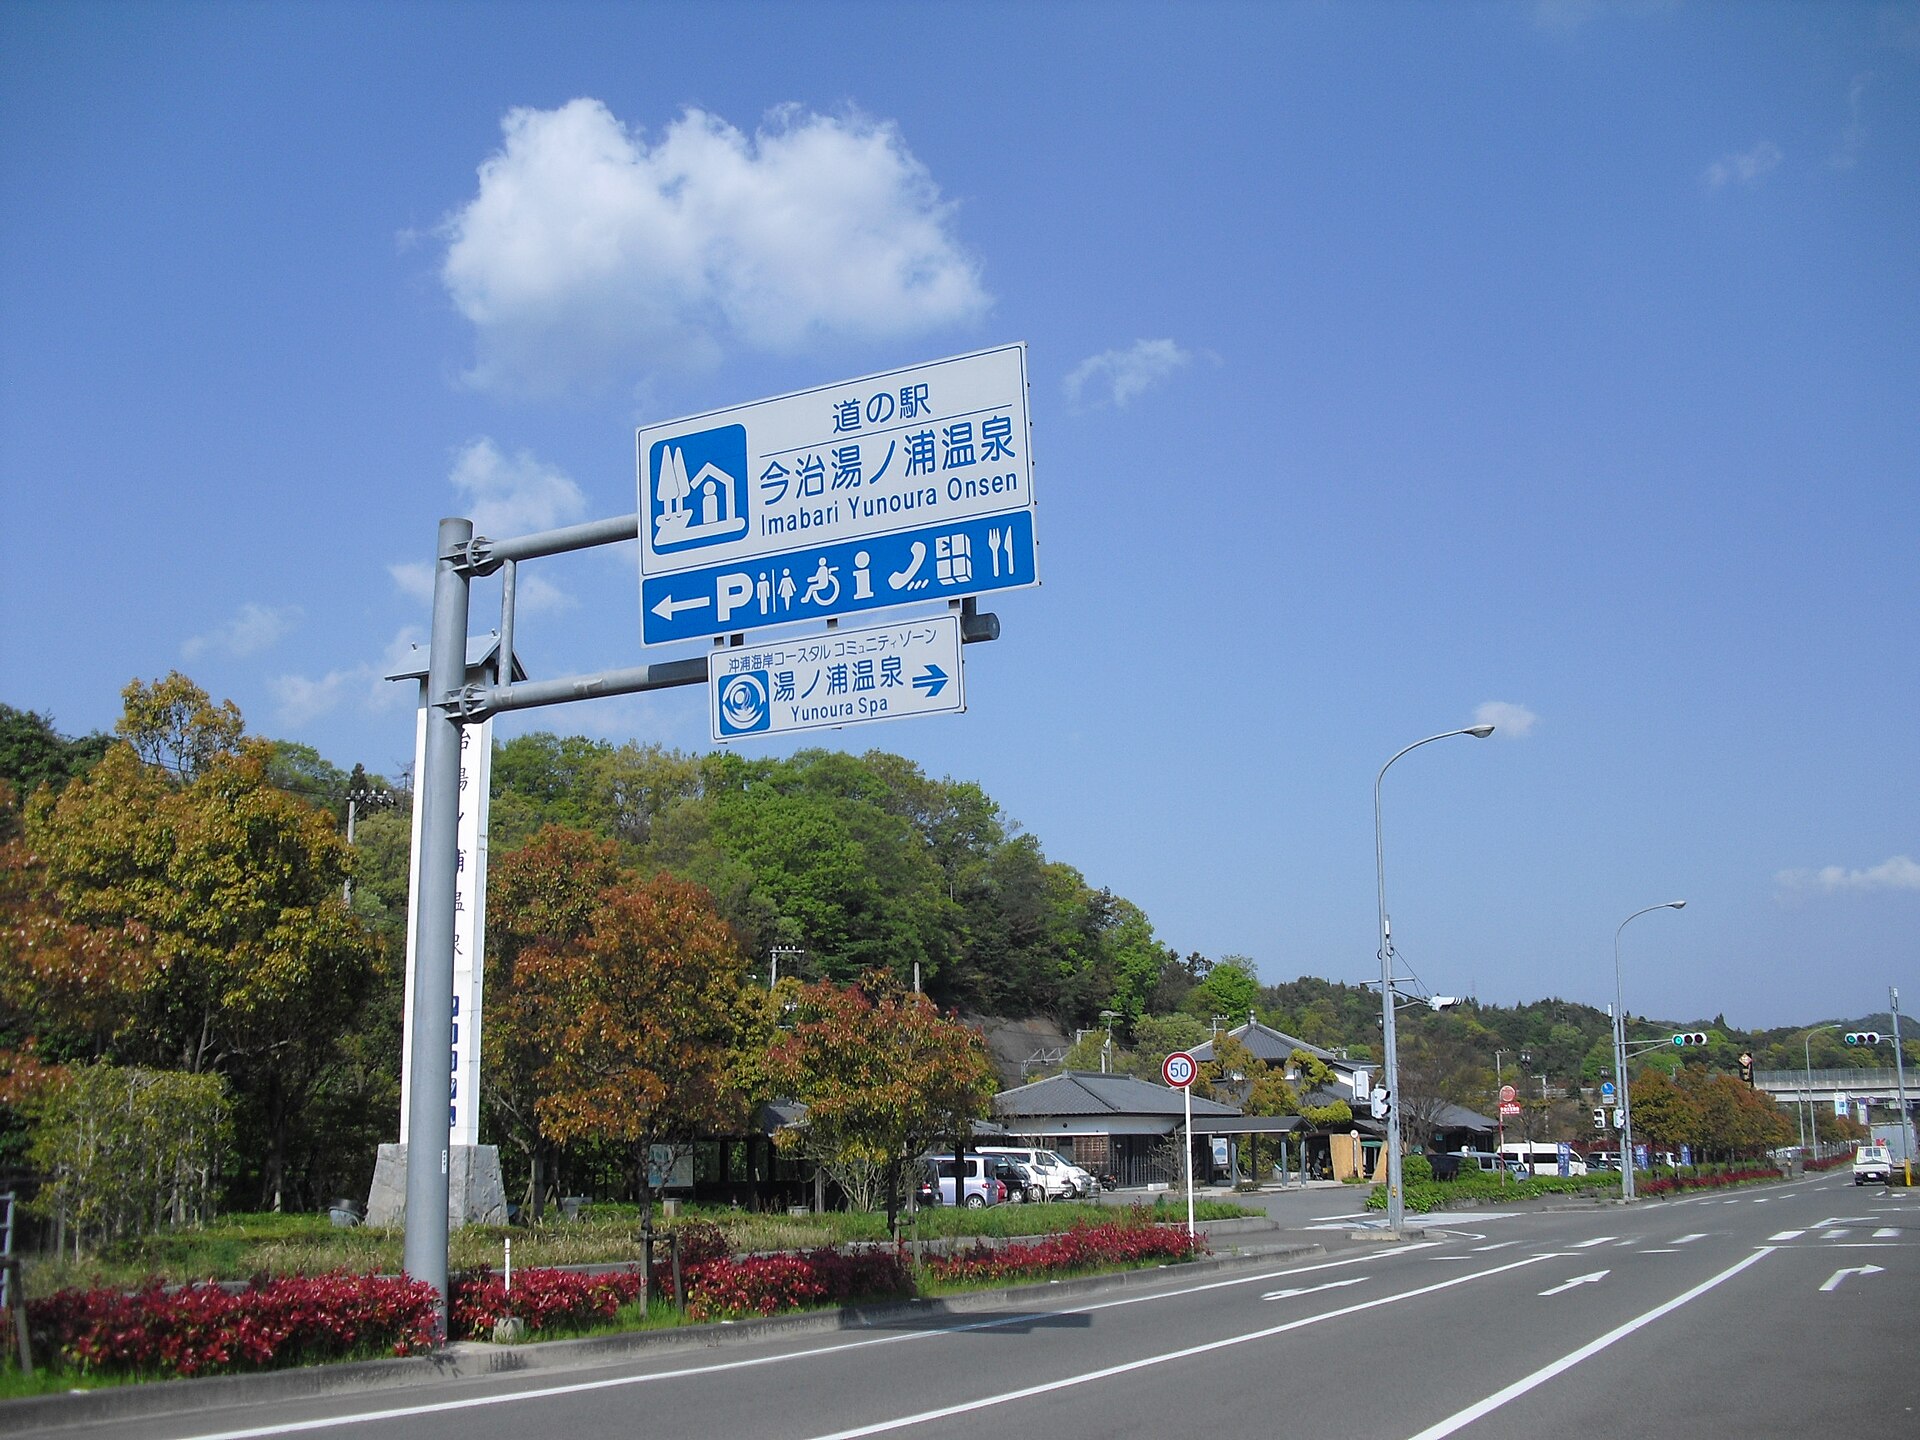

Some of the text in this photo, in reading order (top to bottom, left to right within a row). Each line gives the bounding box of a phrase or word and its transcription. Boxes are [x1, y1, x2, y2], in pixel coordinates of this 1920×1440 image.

[832, 383, 931, 434] 道の駅
[760, 415, 1016, 506] 今治湯ノ浦温泉
[761, 472, 1018, 536] Imabari Yunoura Onsen
[773, 655, 904, 702] 湯ノ浦温泉
[791, 697, 888, 722] Yunoura Spa
[1170, 1062, 1189, 1078] 50
